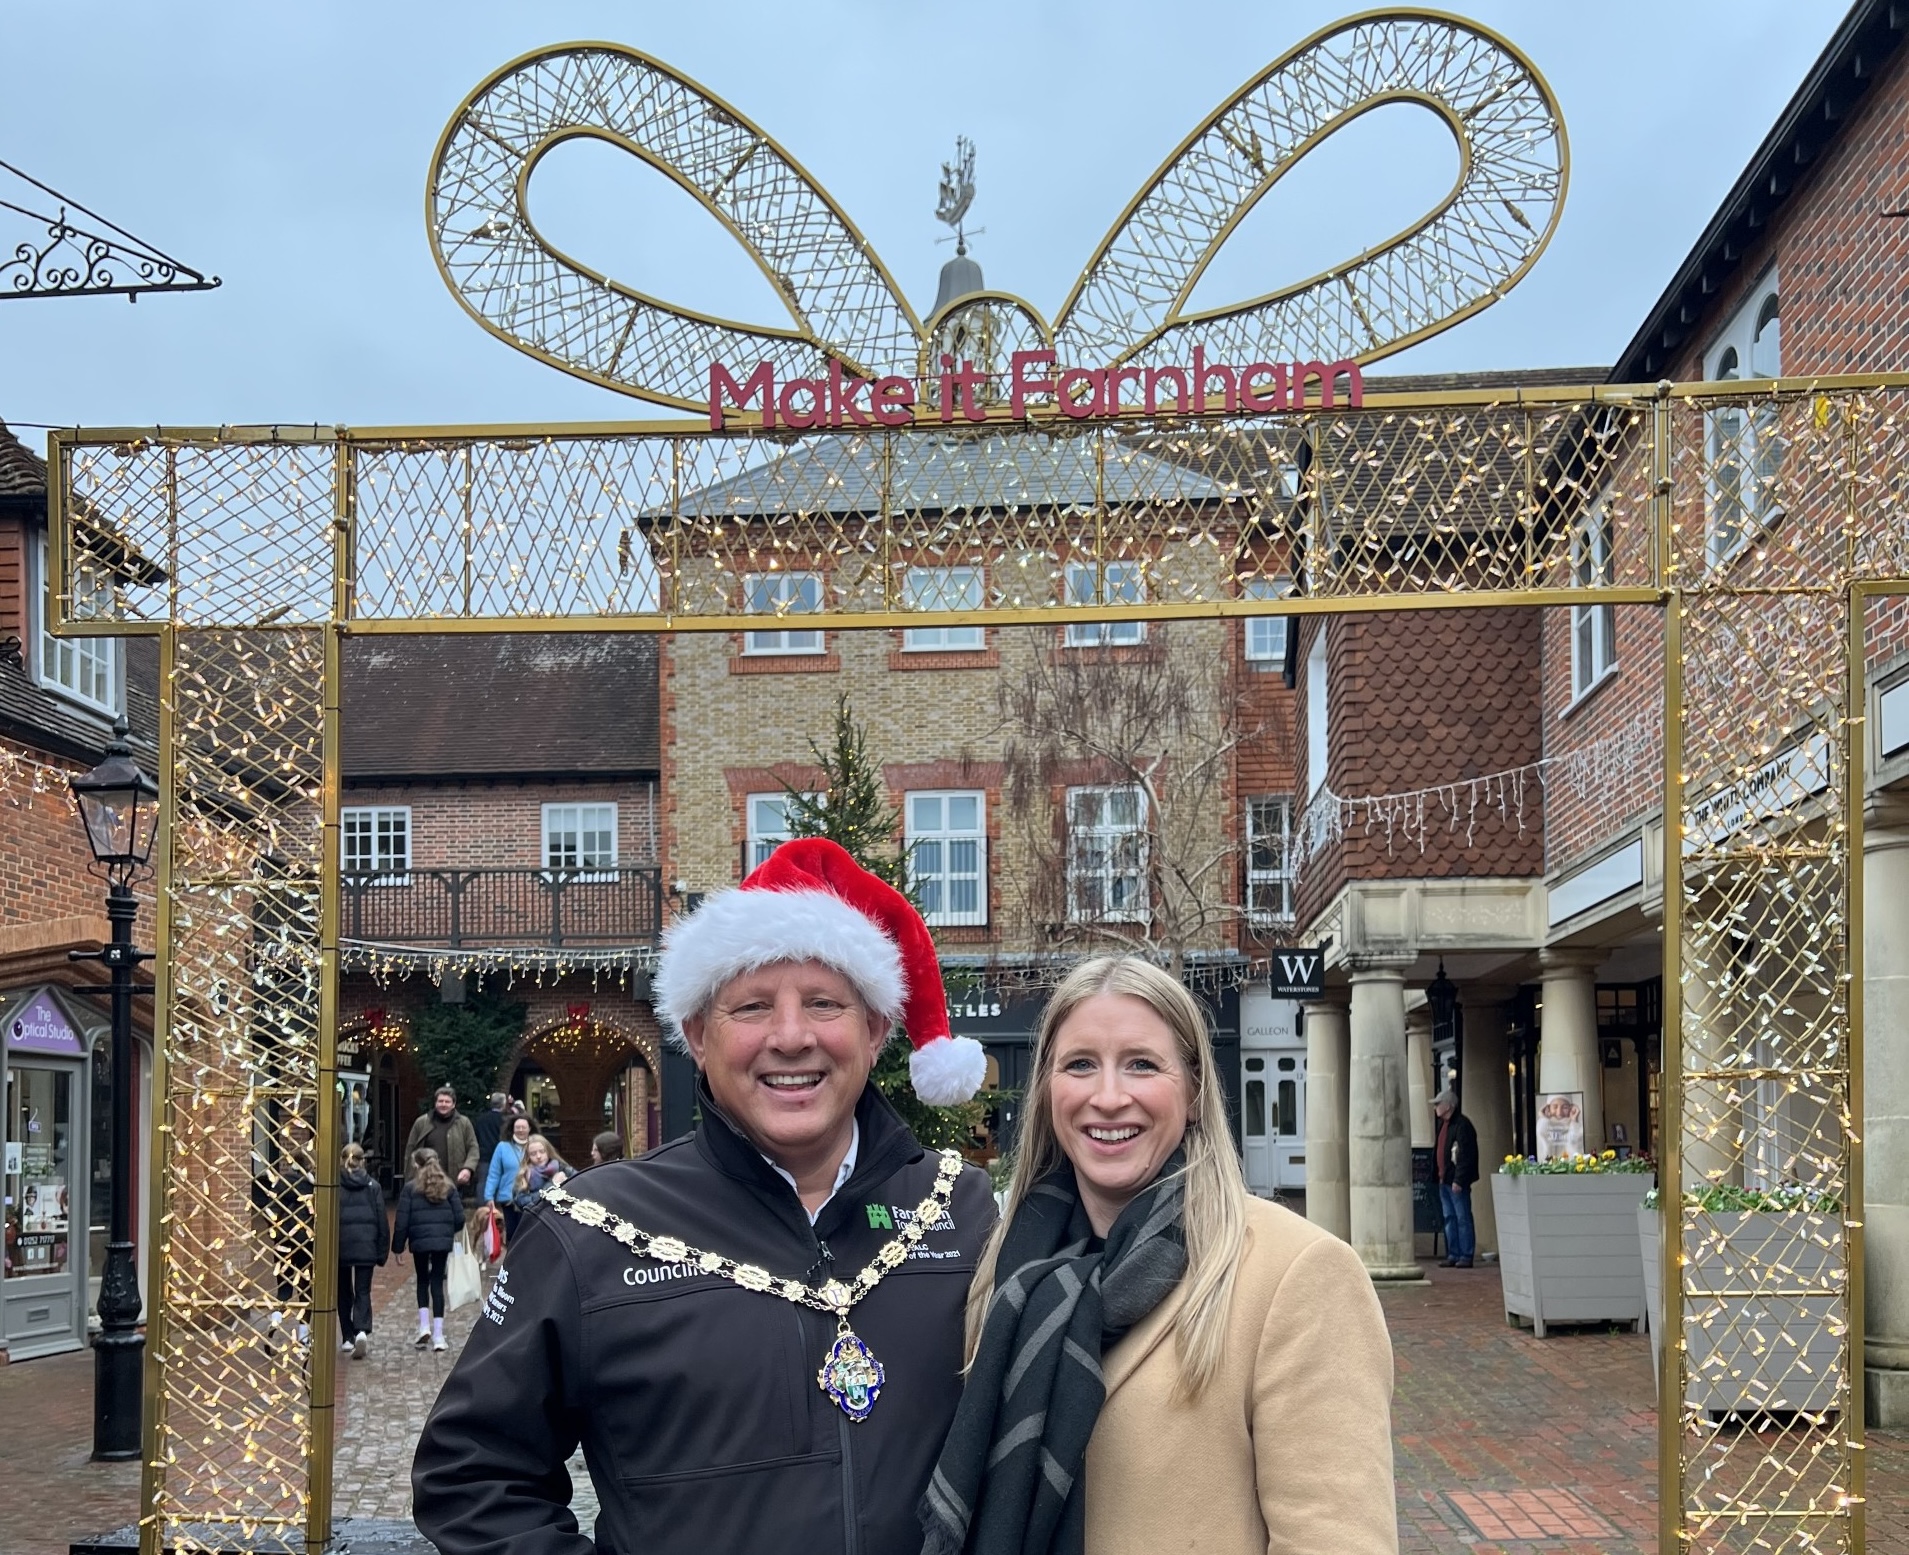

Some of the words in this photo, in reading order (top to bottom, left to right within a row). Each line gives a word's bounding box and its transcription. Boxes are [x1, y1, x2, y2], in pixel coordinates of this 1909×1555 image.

[710, 359, 914, 429] Make
[940, 354, 988, 423] it
[1012, 346, 1363, 419] Farnham
[1278, 955, 1319, 985] W
[36, 1006, 52, 1022] The
[11, 1018, 48, 1041] Optical
[48, 1023, 74, 1041] Studio
[1247, 1026, 1289, 1036] GALLEON
